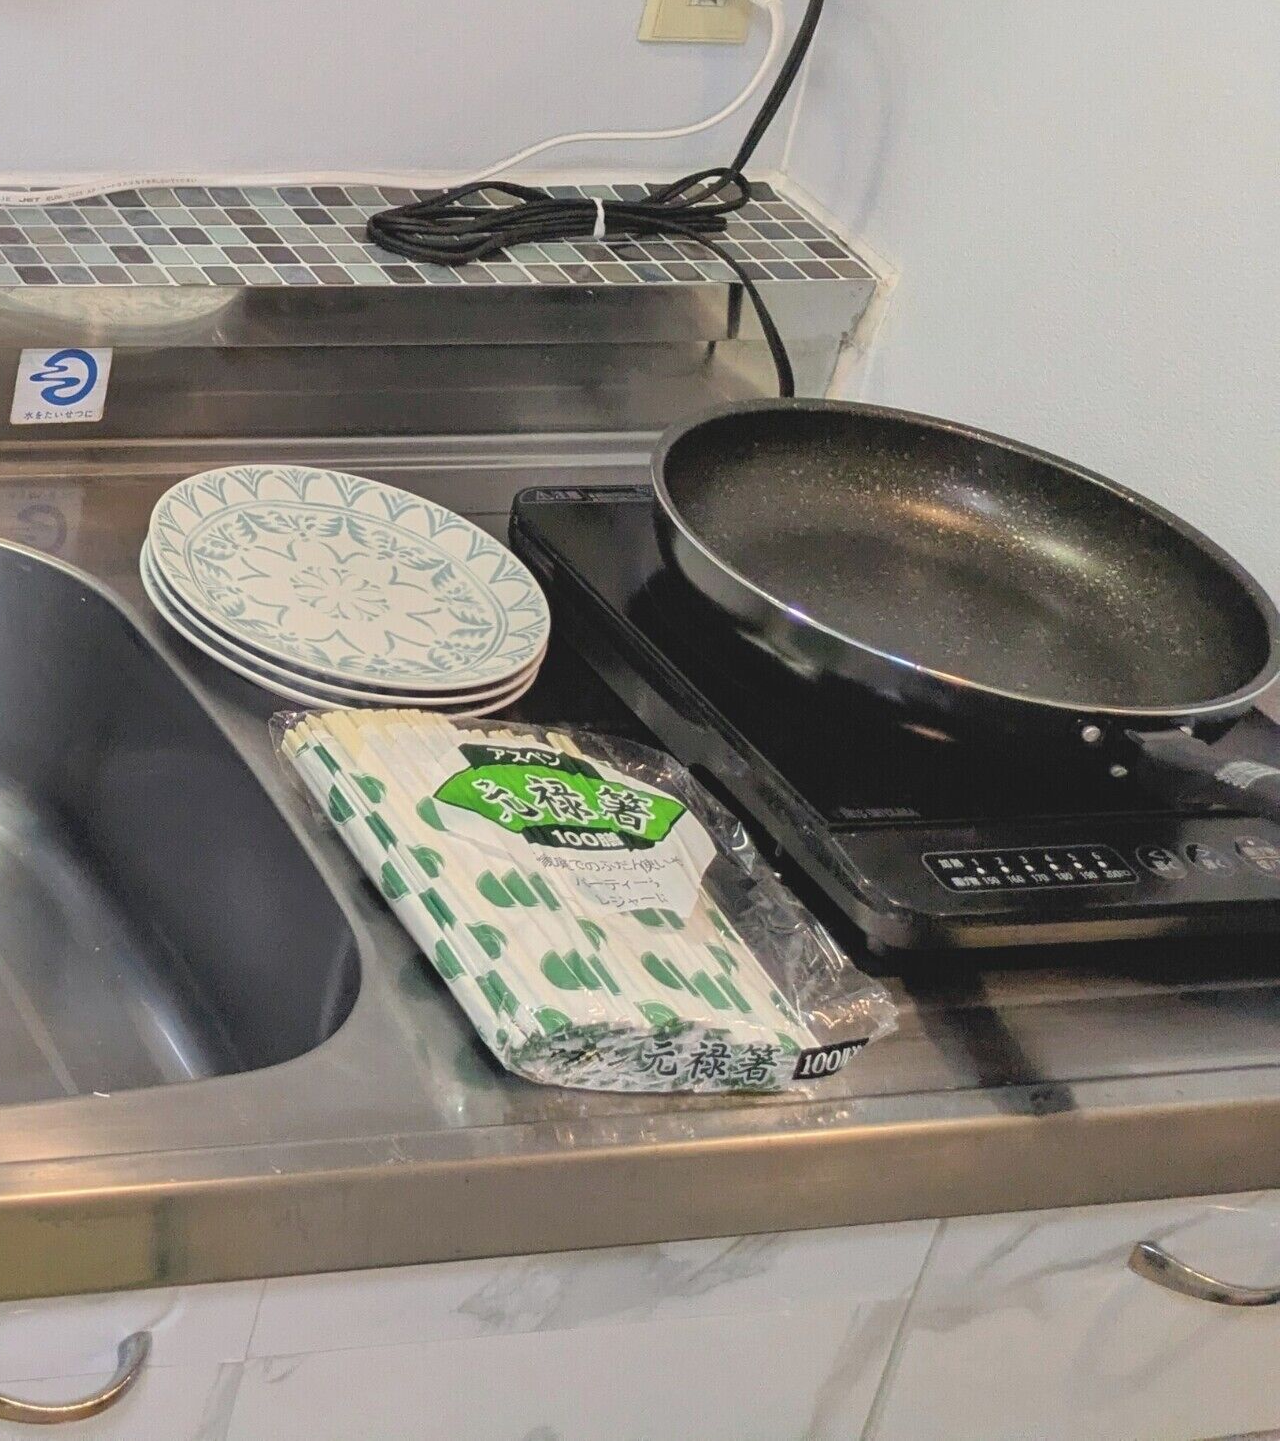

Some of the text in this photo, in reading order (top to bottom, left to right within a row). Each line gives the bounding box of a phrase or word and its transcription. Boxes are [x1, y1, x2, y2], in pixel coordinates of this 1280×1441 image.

[23, 409, 94, 421] 水をたいせつに
[486, 746, 561, 767] アスペン
[471, 774, 656, 837] 元禄箸
